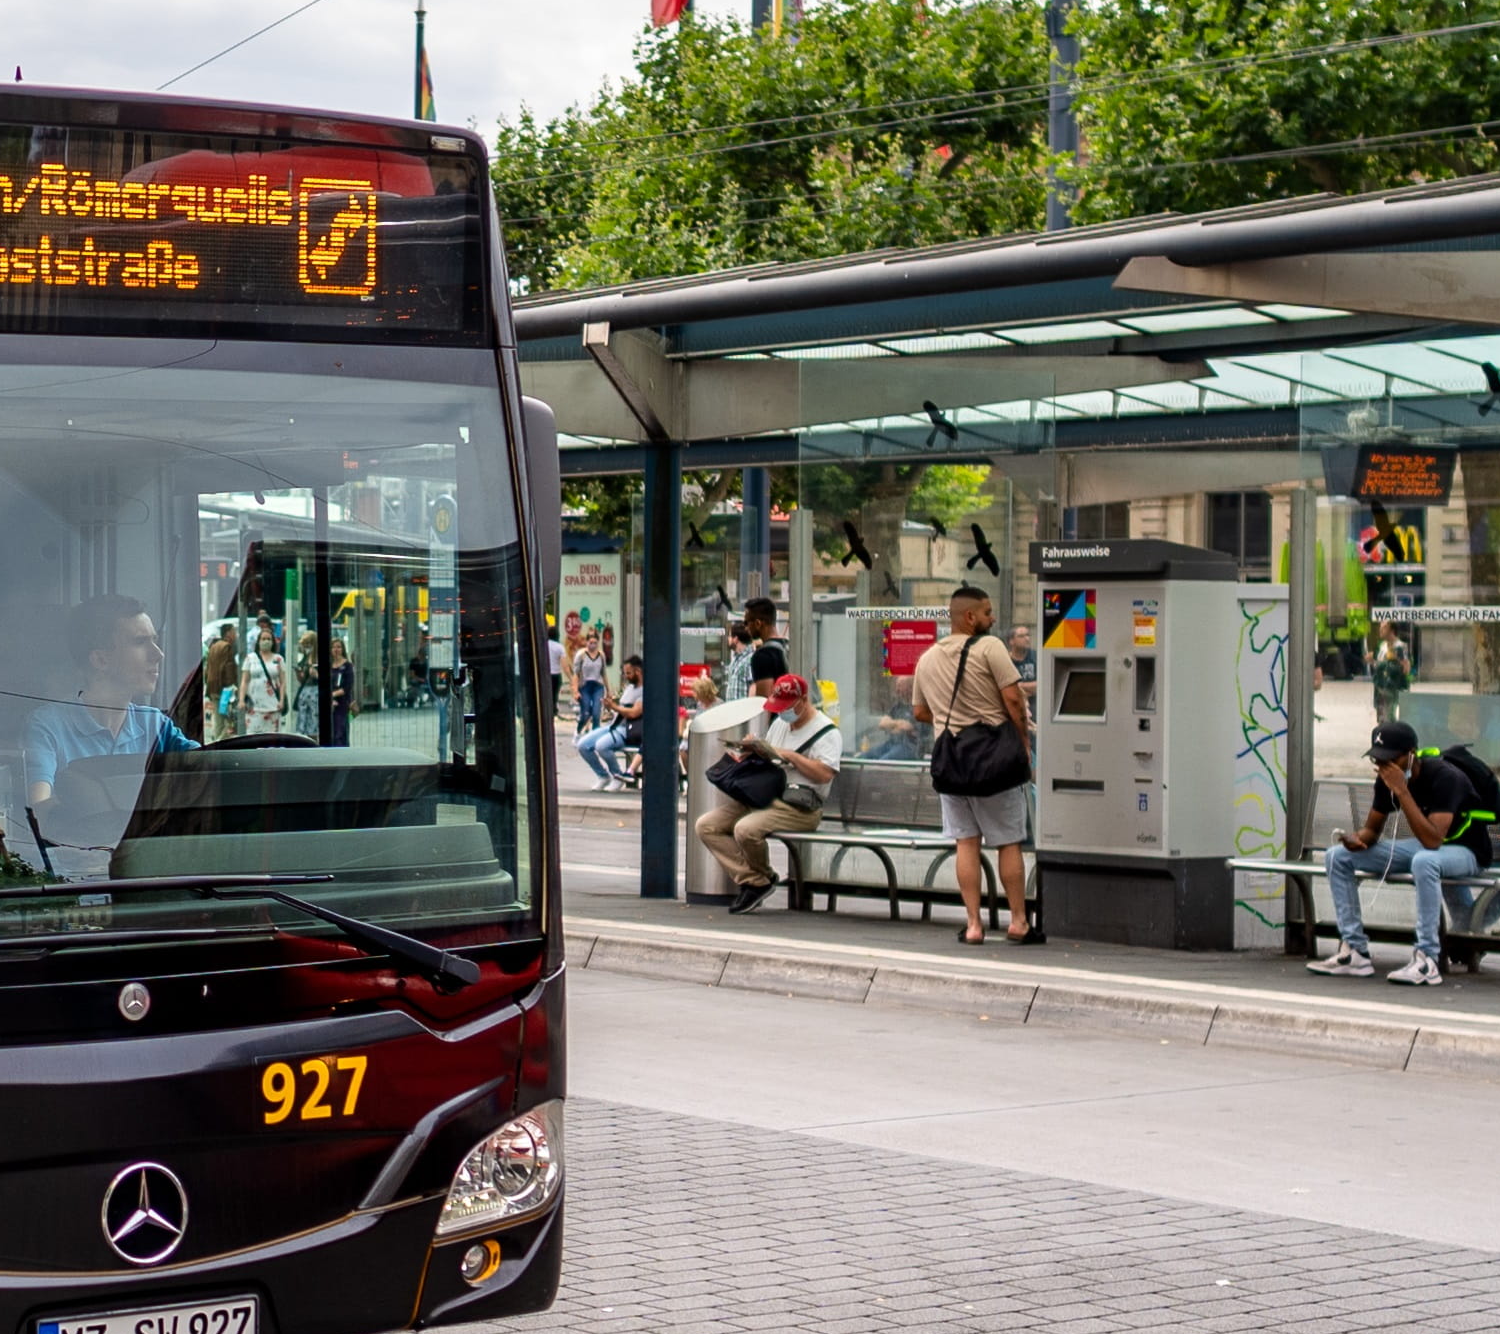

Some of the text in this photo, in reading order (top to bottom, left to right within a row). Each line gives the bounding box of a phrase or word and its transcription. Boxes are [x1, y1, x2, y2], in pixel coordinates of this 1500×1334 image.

[1042, 545, 1111, 558] Fahrausweise
[579, 564, 601, 574] DEIN
[564, 573, 617, 586] SPAR-MENÜ
[847, 609, 907, 619] WARTEBEREICH
[909, 607, 923, 619] FÜR
[1374, 609, 1456, 620] WARTEBEREICH
[1458, 608, 1480, 620] FÜR
[262, 1055, 368, 1124] 927
